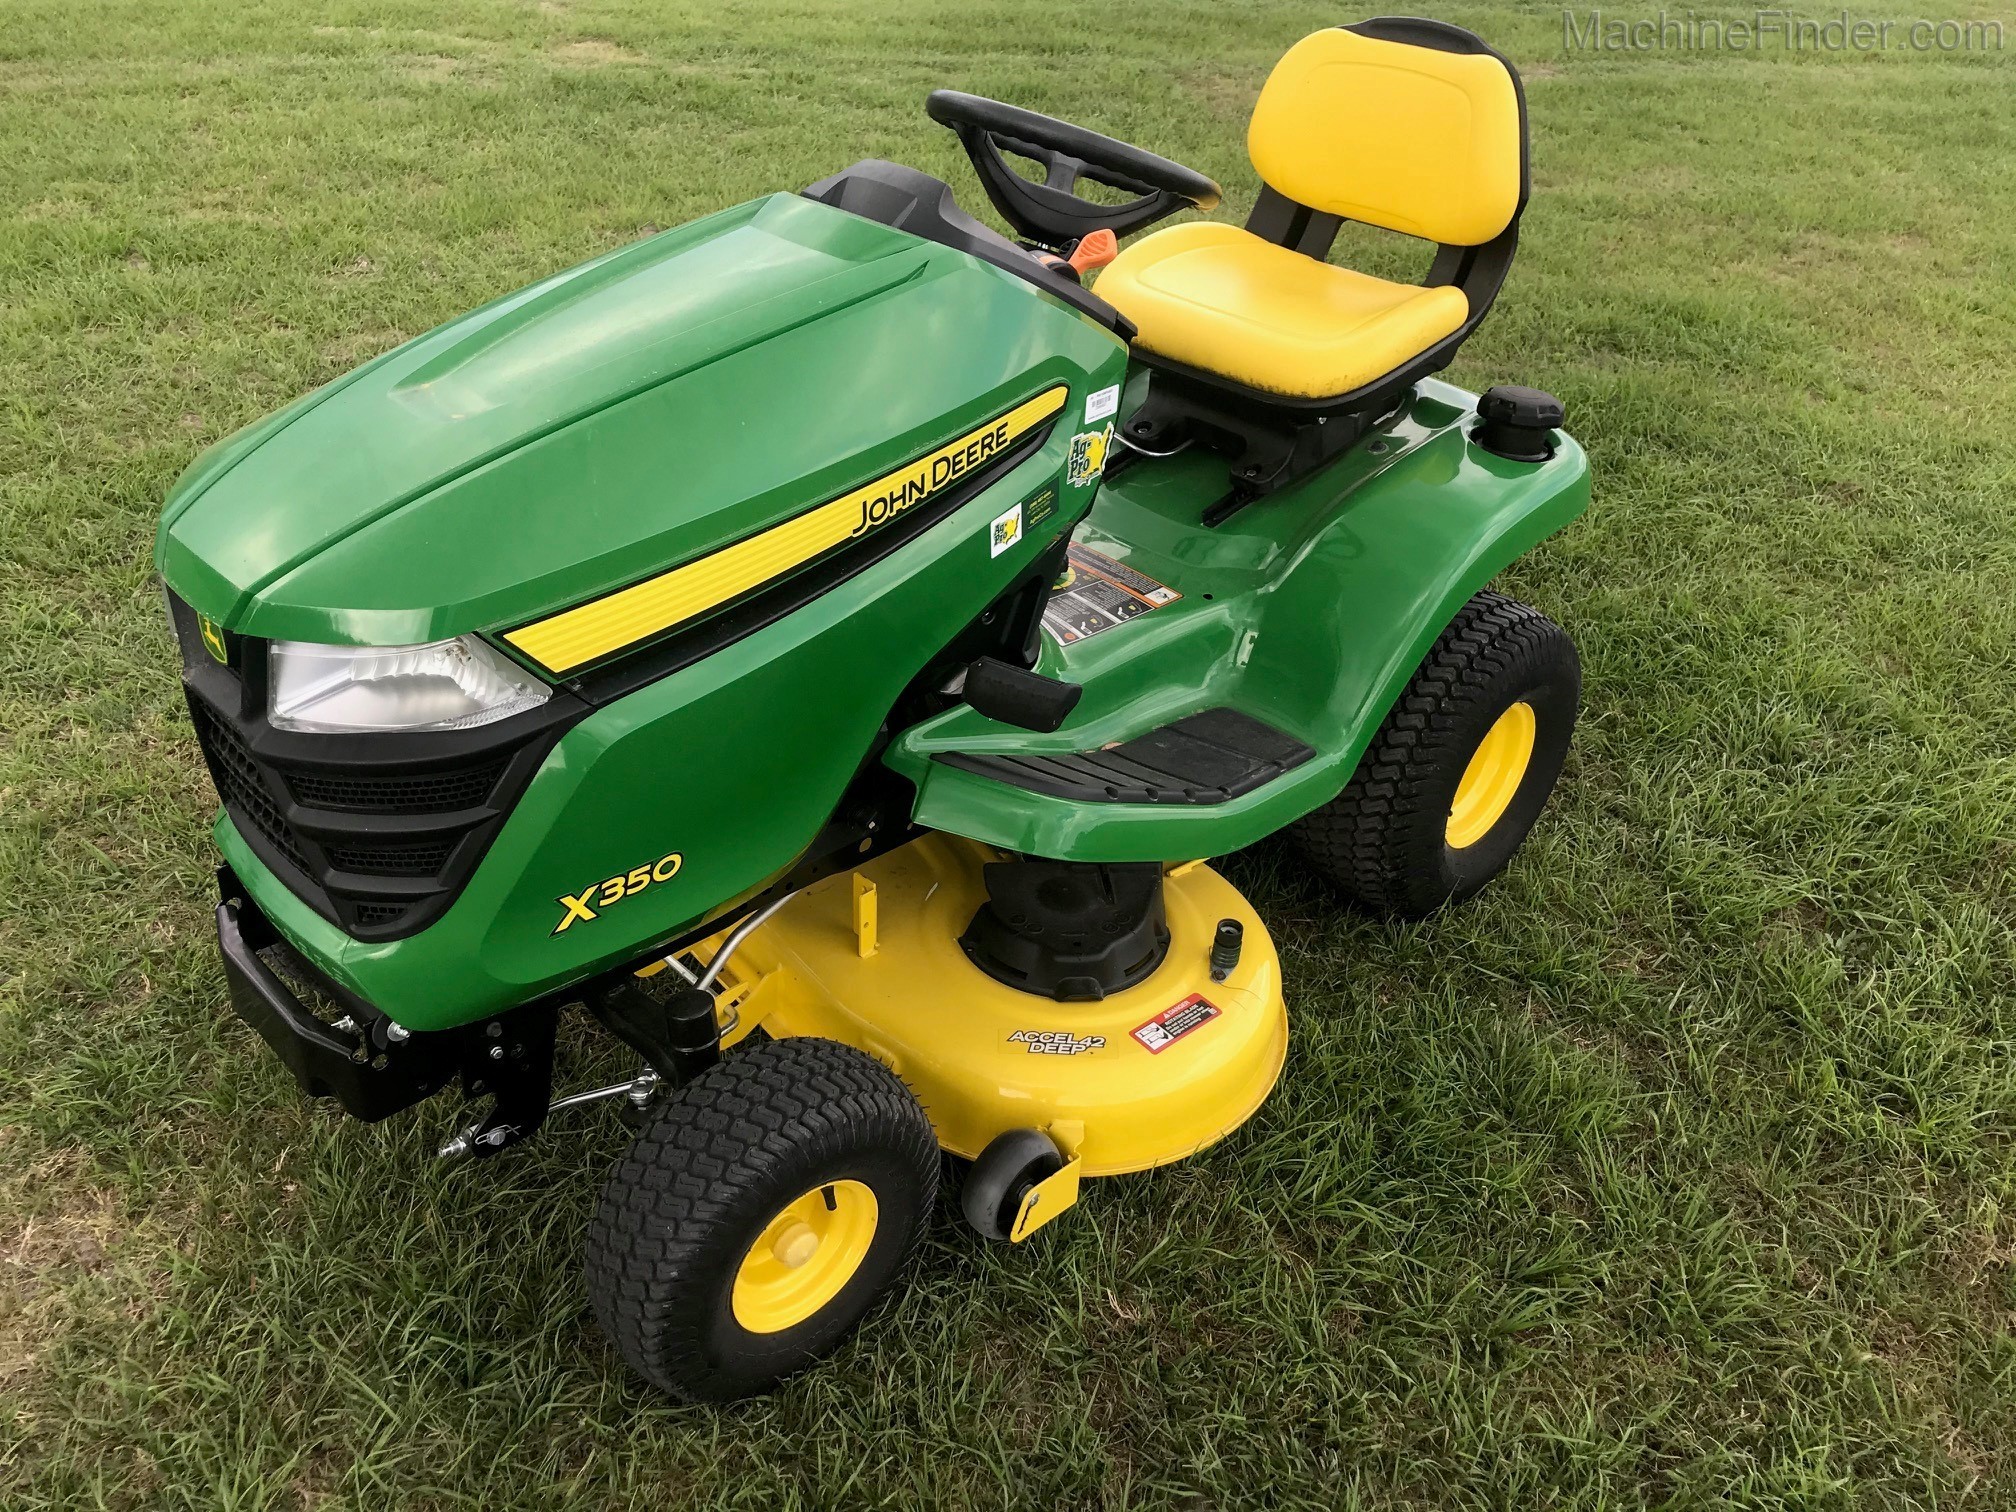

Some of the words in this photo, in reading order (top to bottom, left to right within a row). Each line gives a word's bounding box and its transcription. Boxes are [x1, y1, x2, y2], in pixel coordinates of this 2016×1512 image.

[852, 473, 926, 536] JOHN
[932, 421, 1009, 489] DEERE
[1069, 458, 1090, 480] Pro
[549, 851, 684, 937] X350
[1028, 1042, 1087, 1056] DEEP
